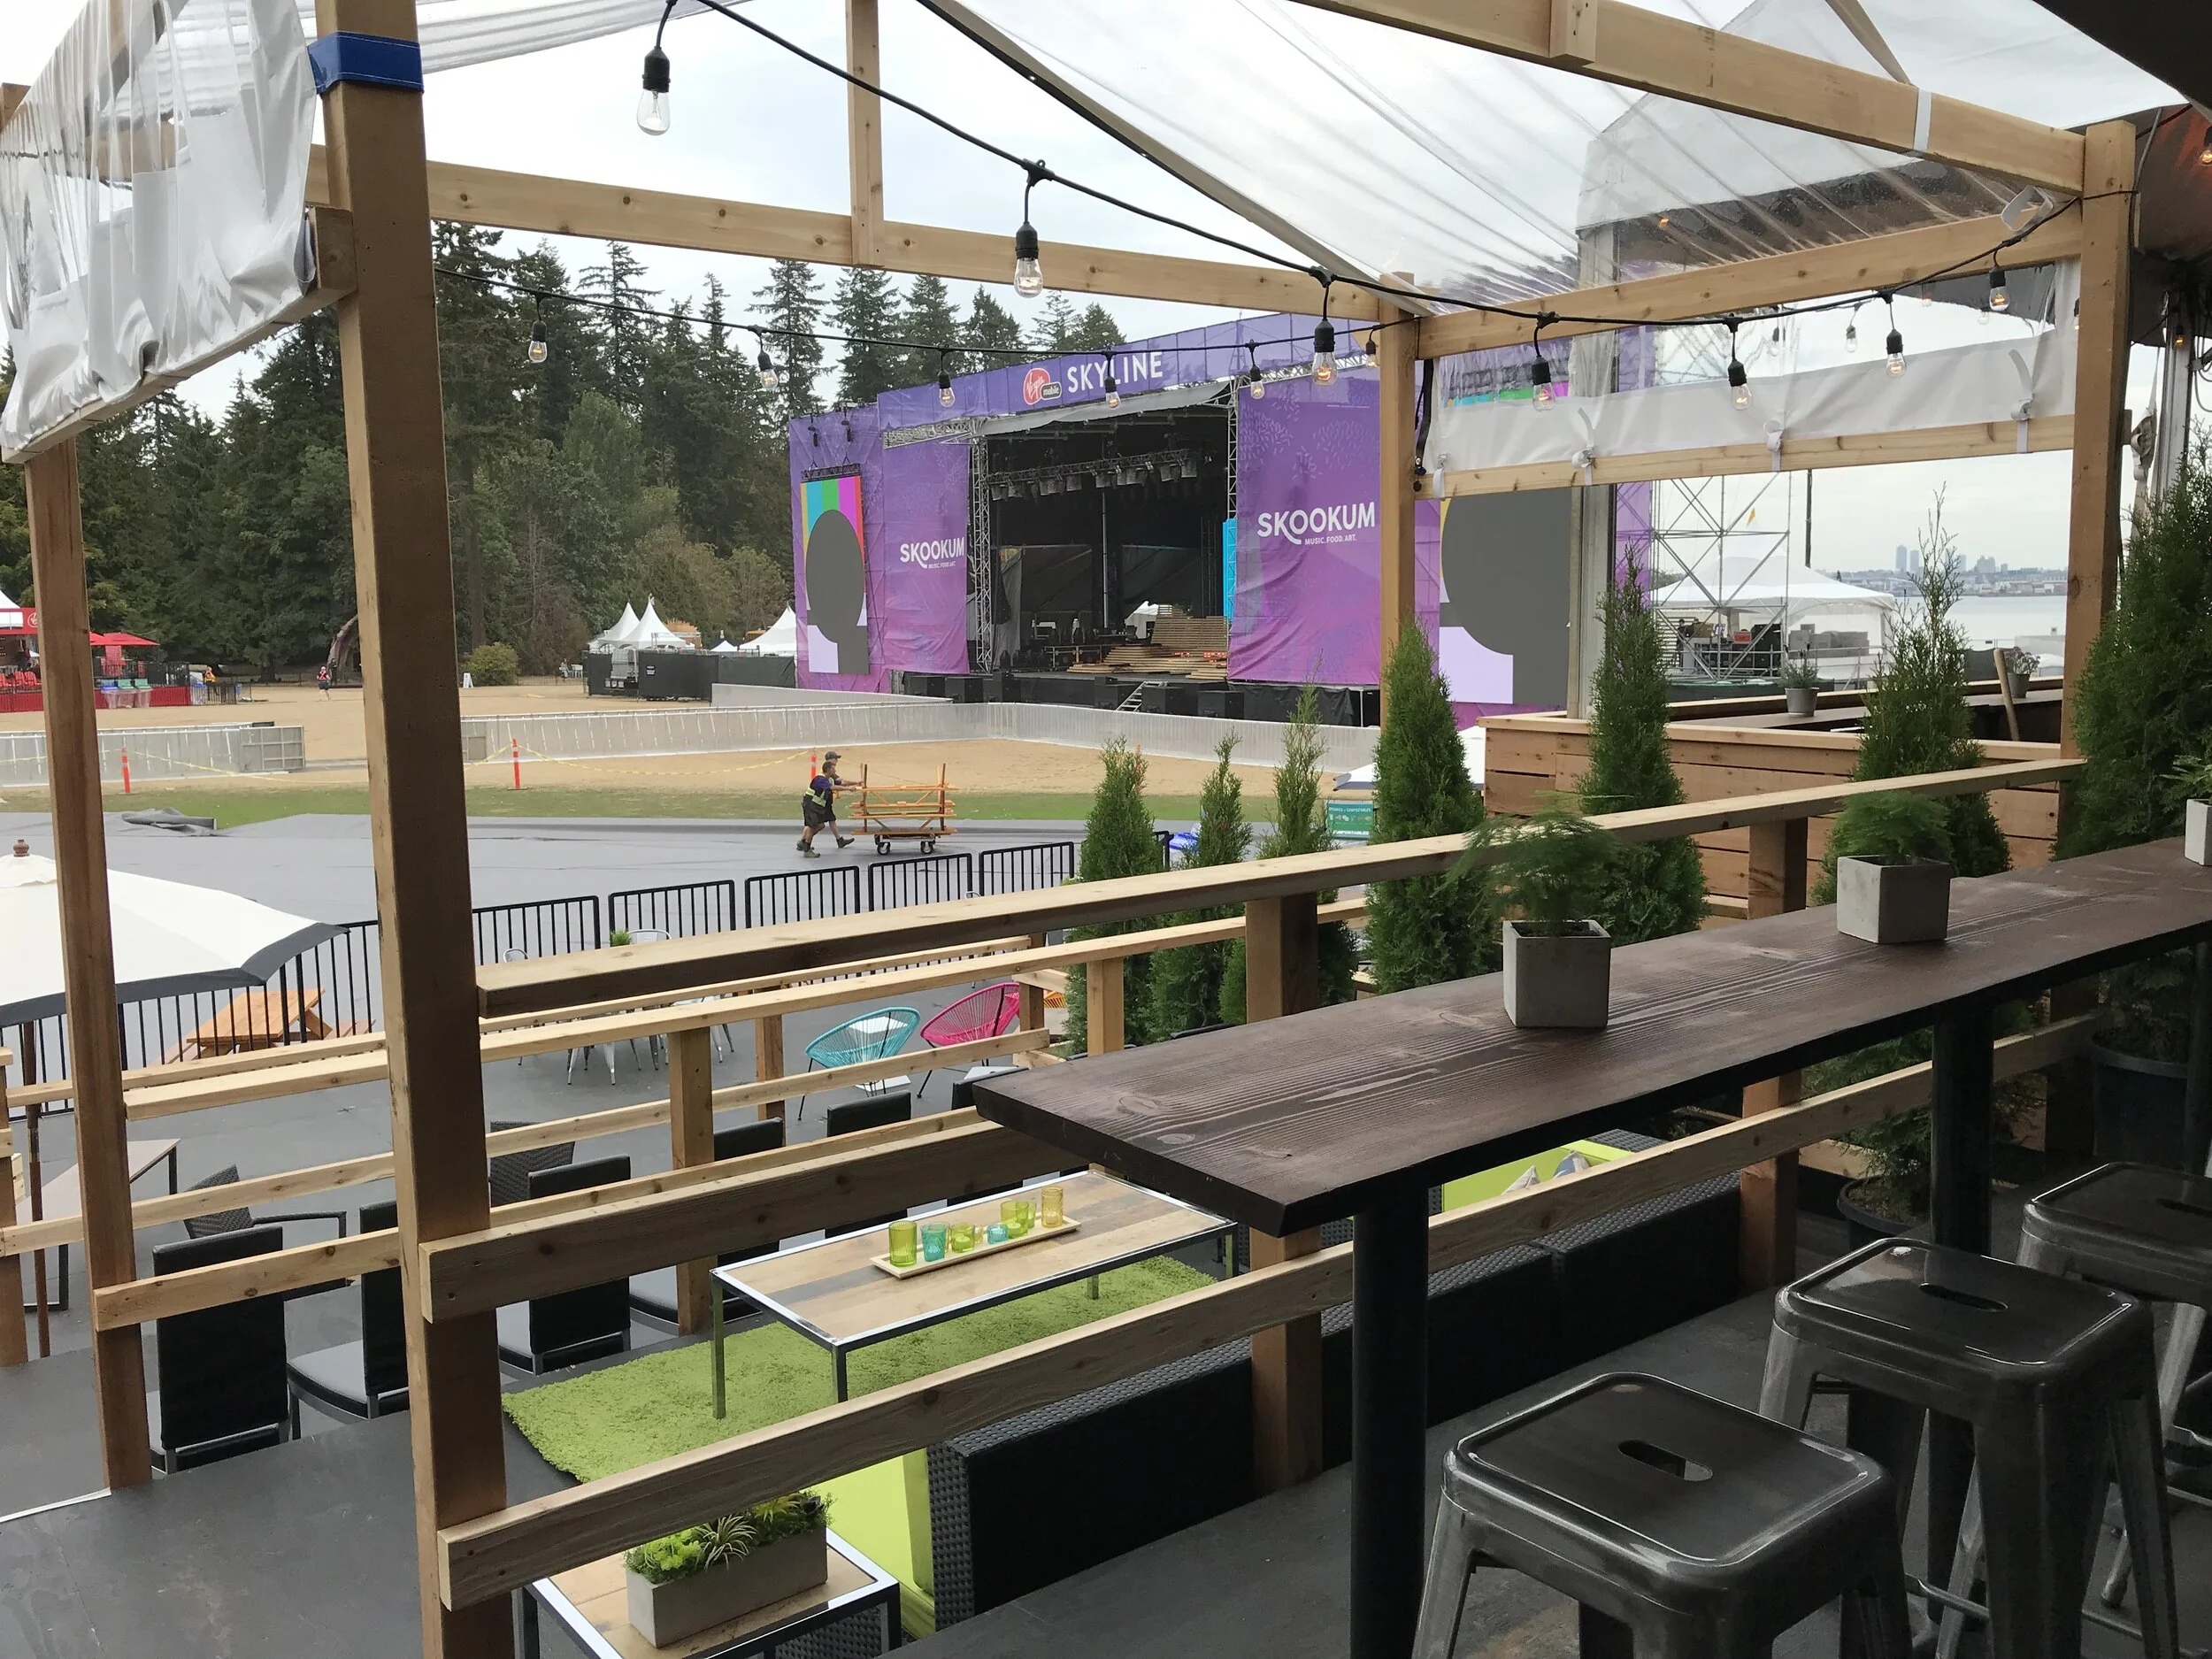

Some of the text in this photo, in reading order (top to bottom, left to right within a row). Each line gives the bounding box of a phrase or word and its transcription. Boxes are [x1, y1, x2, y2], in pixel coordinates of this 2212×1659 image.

[1067, 351, 1164, 393] SKYLINE
[1256, 501, 1375, 545] SKOOKUM
[1304, 537, 1325, 546] MUSIC.
[900, 536, 964, 569] SKOOKUM
